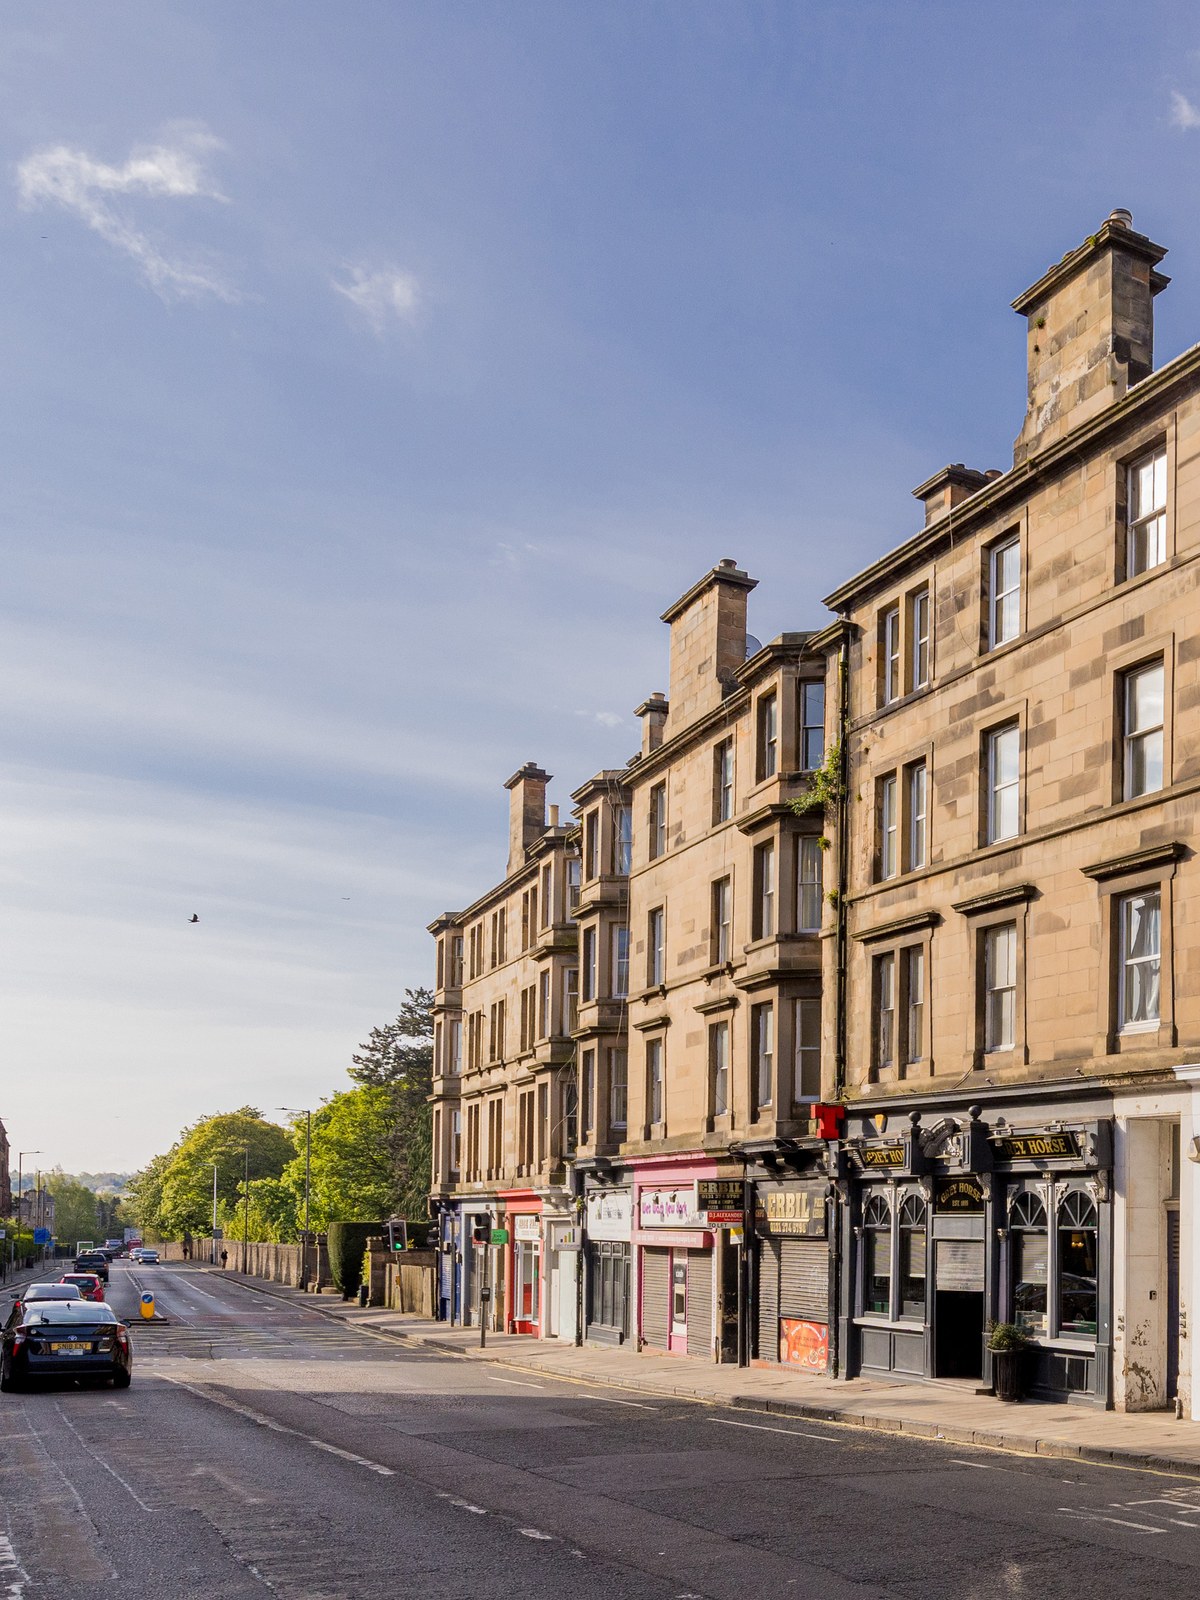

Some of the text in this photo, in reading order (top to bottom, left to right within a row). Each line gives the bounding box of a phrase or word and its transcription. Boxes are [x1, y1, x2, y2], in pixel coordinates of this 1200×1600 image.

[1027, 1137, 1068, 1155] HORSE
[699, 1182, 743, 1193] ERBIL
[941, 1182, 981, 1203] GREY HORSE
[767, 1193, 810, 1218] ERBIL
